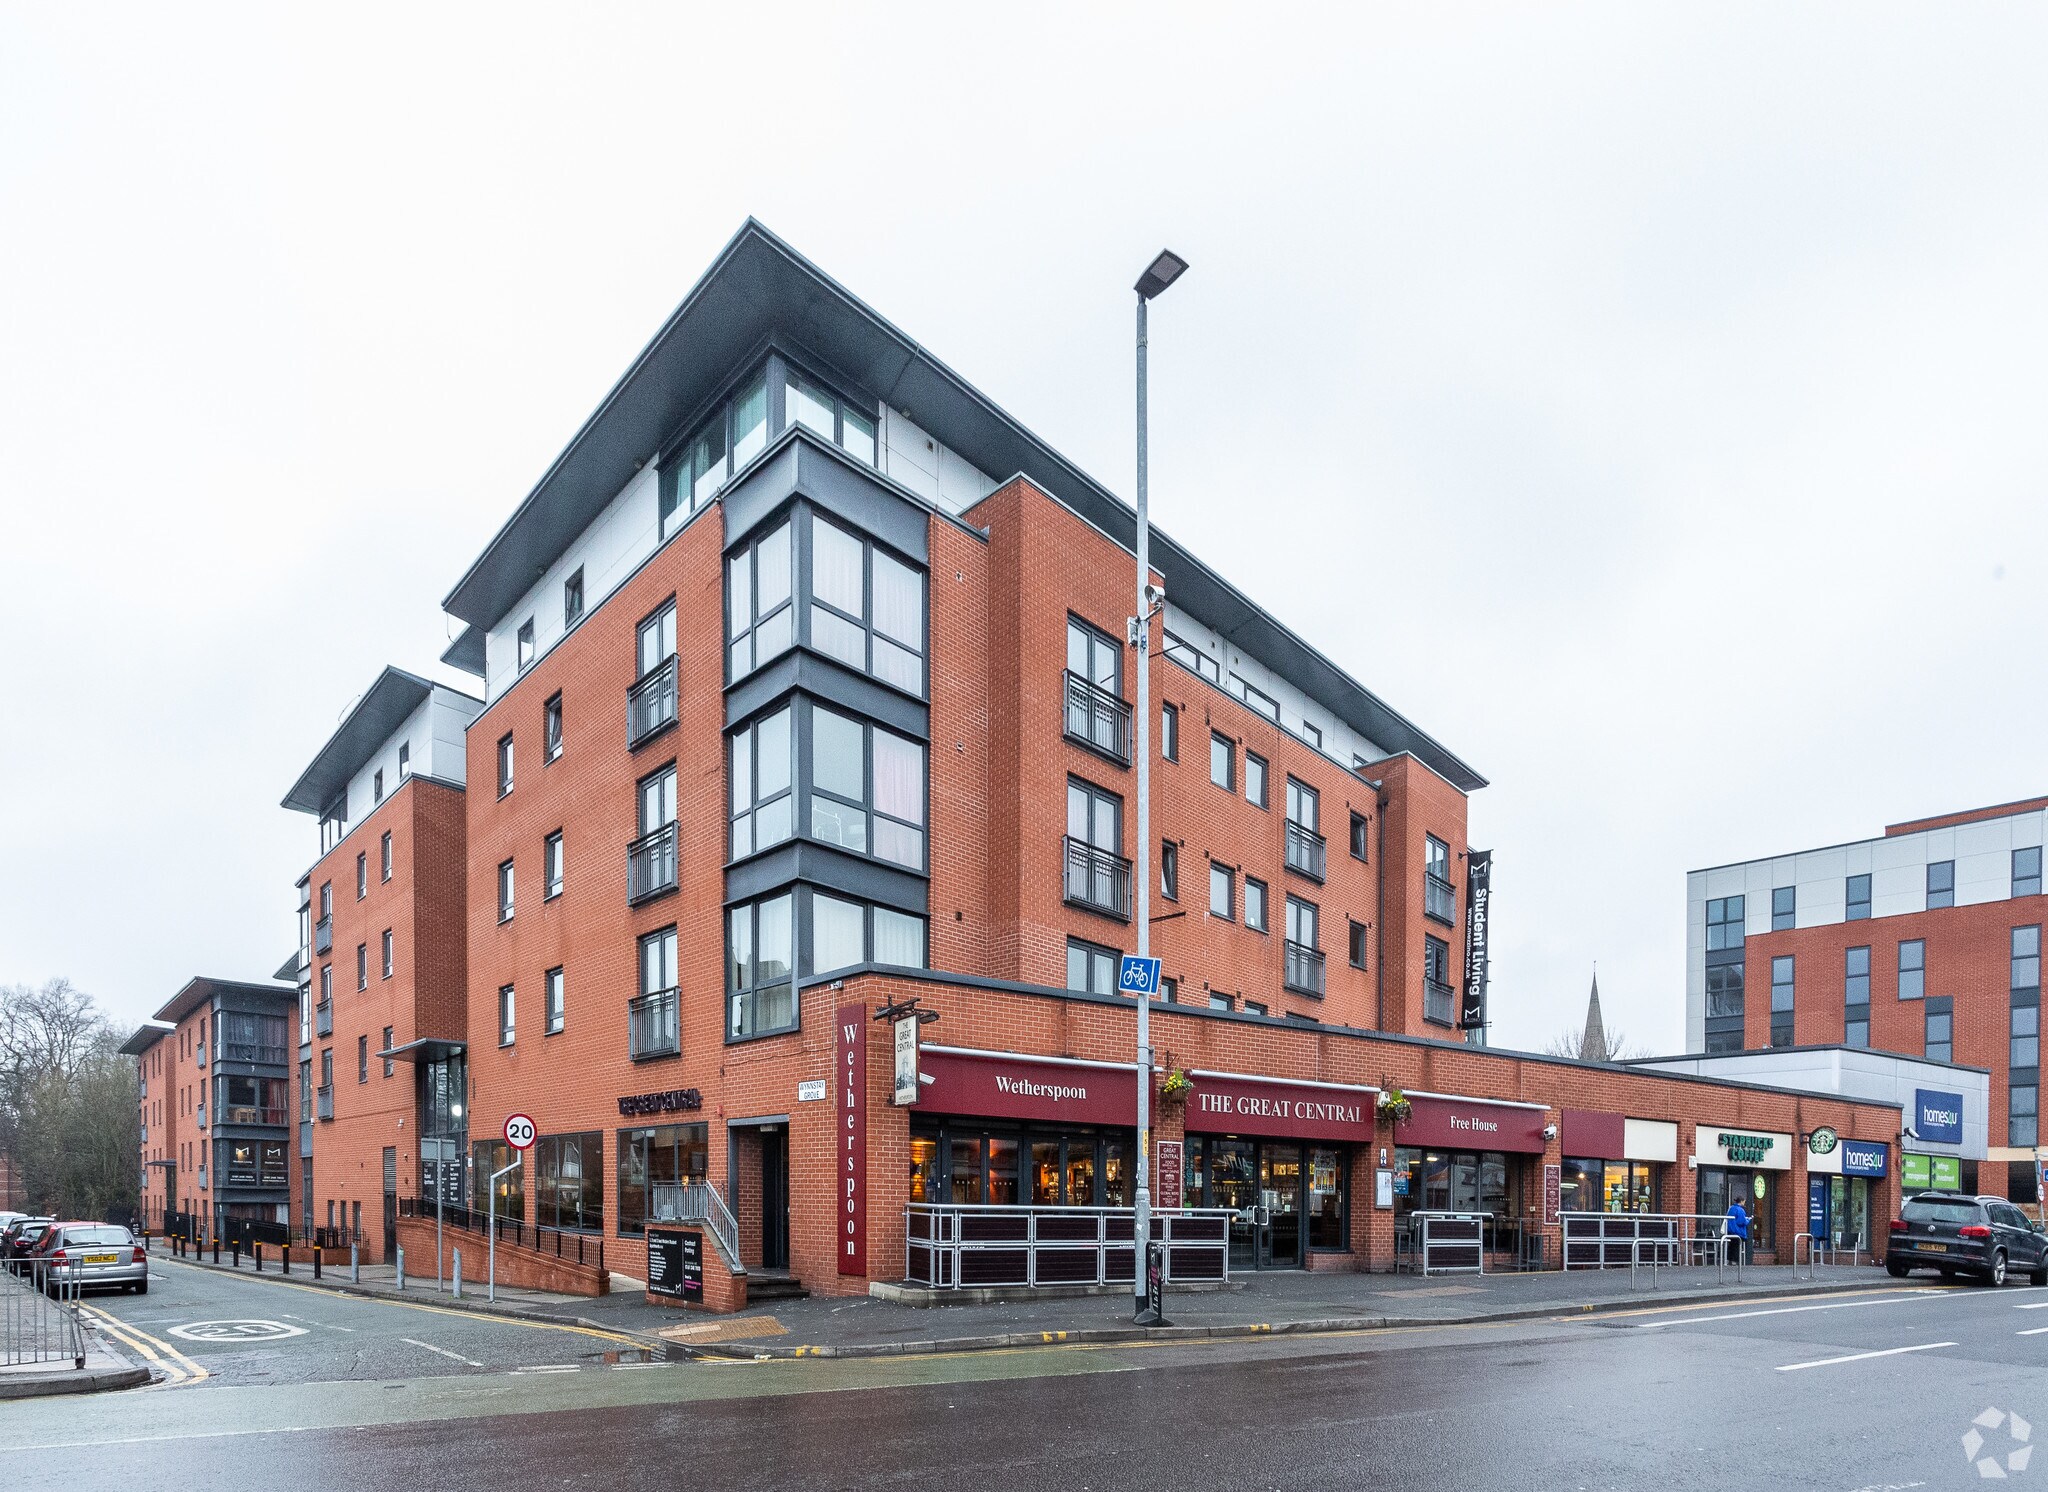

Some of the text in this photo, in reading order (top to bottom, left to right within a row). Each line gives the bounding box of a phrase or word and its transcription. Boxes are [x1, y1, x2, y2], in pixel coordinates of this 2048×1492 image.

[1469, 888, 1487, 996] Student Living
[899, 1029, 911, 1041] GREAT
[896, 1040, 915, 1053] CENTRAL
[799, 1081, 825, 1091] WYNNSTAY
[995, 1076, 1086, 1101] Wetherspoon
[803, 1090, 820, 1100] GROVE
[1199, 1093, 1364, 1123] THE GREAT CENTRAL
[509, 1123, 533, 1139] 20
[1450, 1115, 1498, 1132] Free House
[844, 1023, 858, 1255] Wetherspoon
[1718, 1133, 1774, 1150] STARBUCKS
[1728, 1147, 1765, 1164] COFFEE
